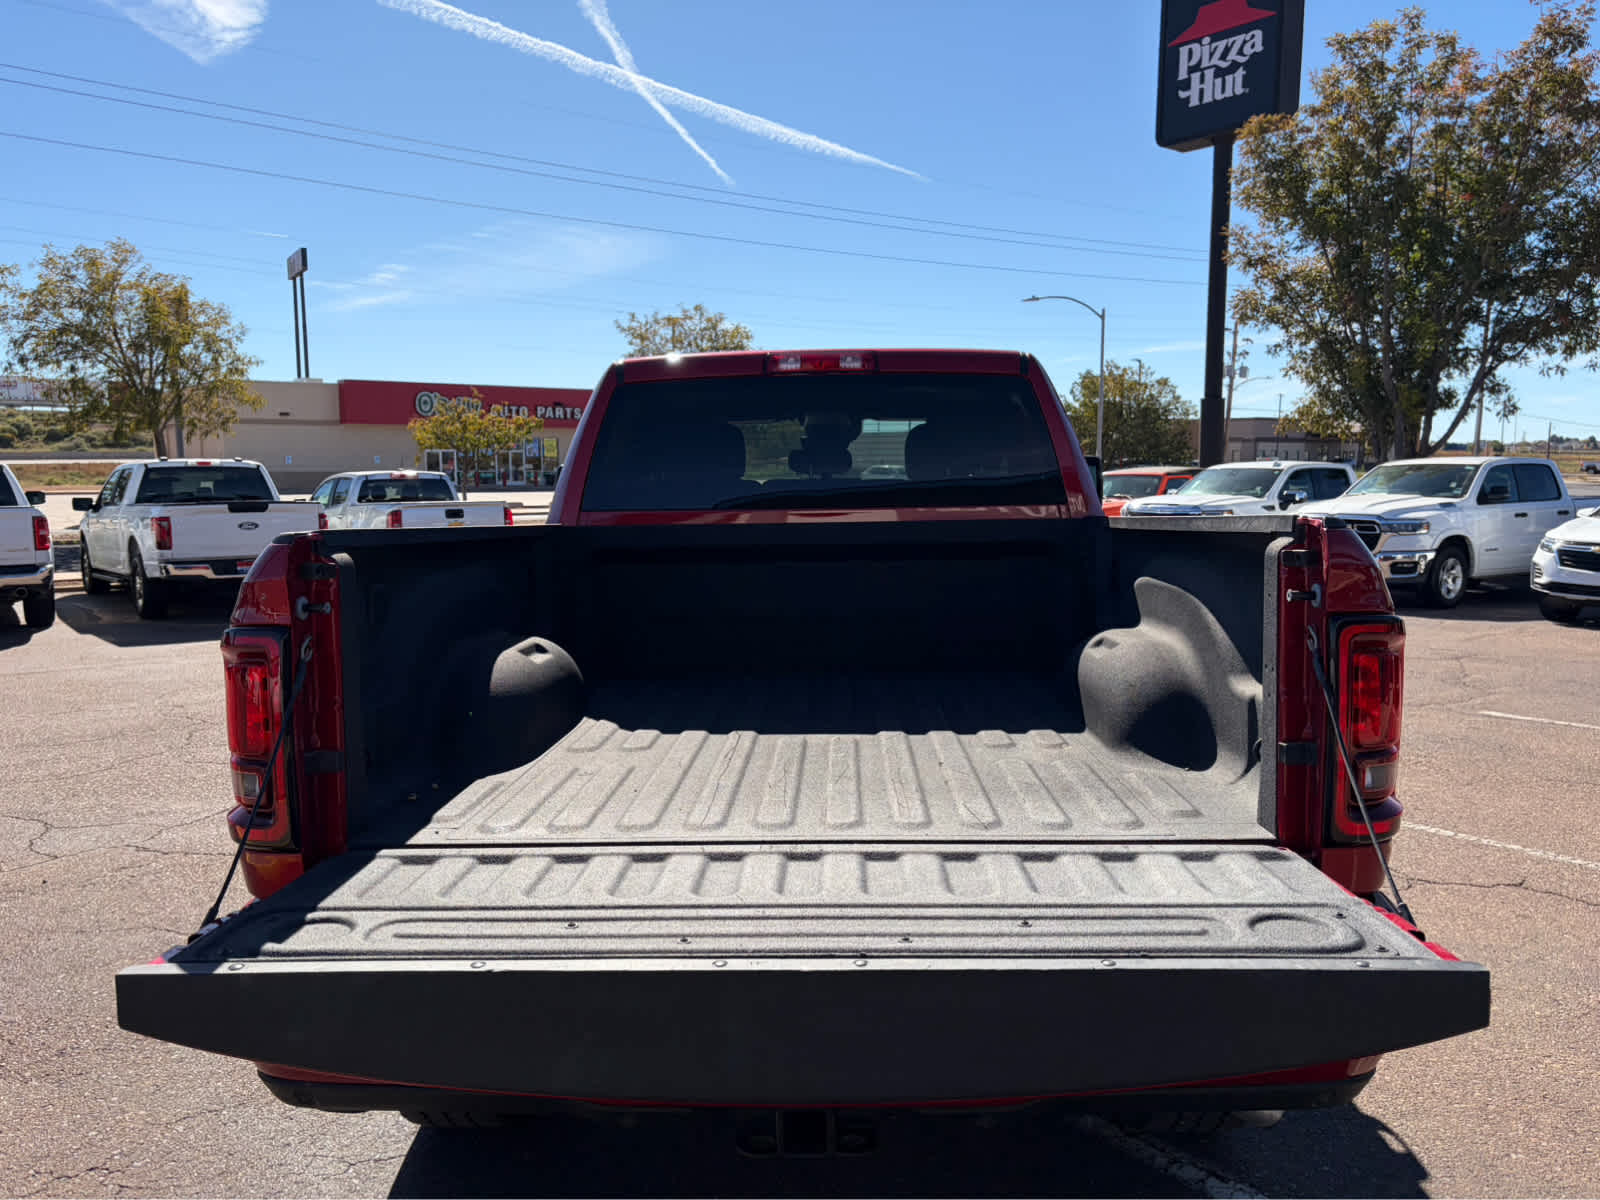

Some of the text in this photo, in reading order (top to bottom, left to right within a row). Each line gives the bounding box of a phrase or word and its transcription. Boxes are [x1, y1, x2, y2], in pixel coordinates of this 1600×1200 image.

[1177, 29, 1264, 81] Pizza
[1178, 65, 1246, 108] Hut
[537, 406, 582, 420] PARTS
